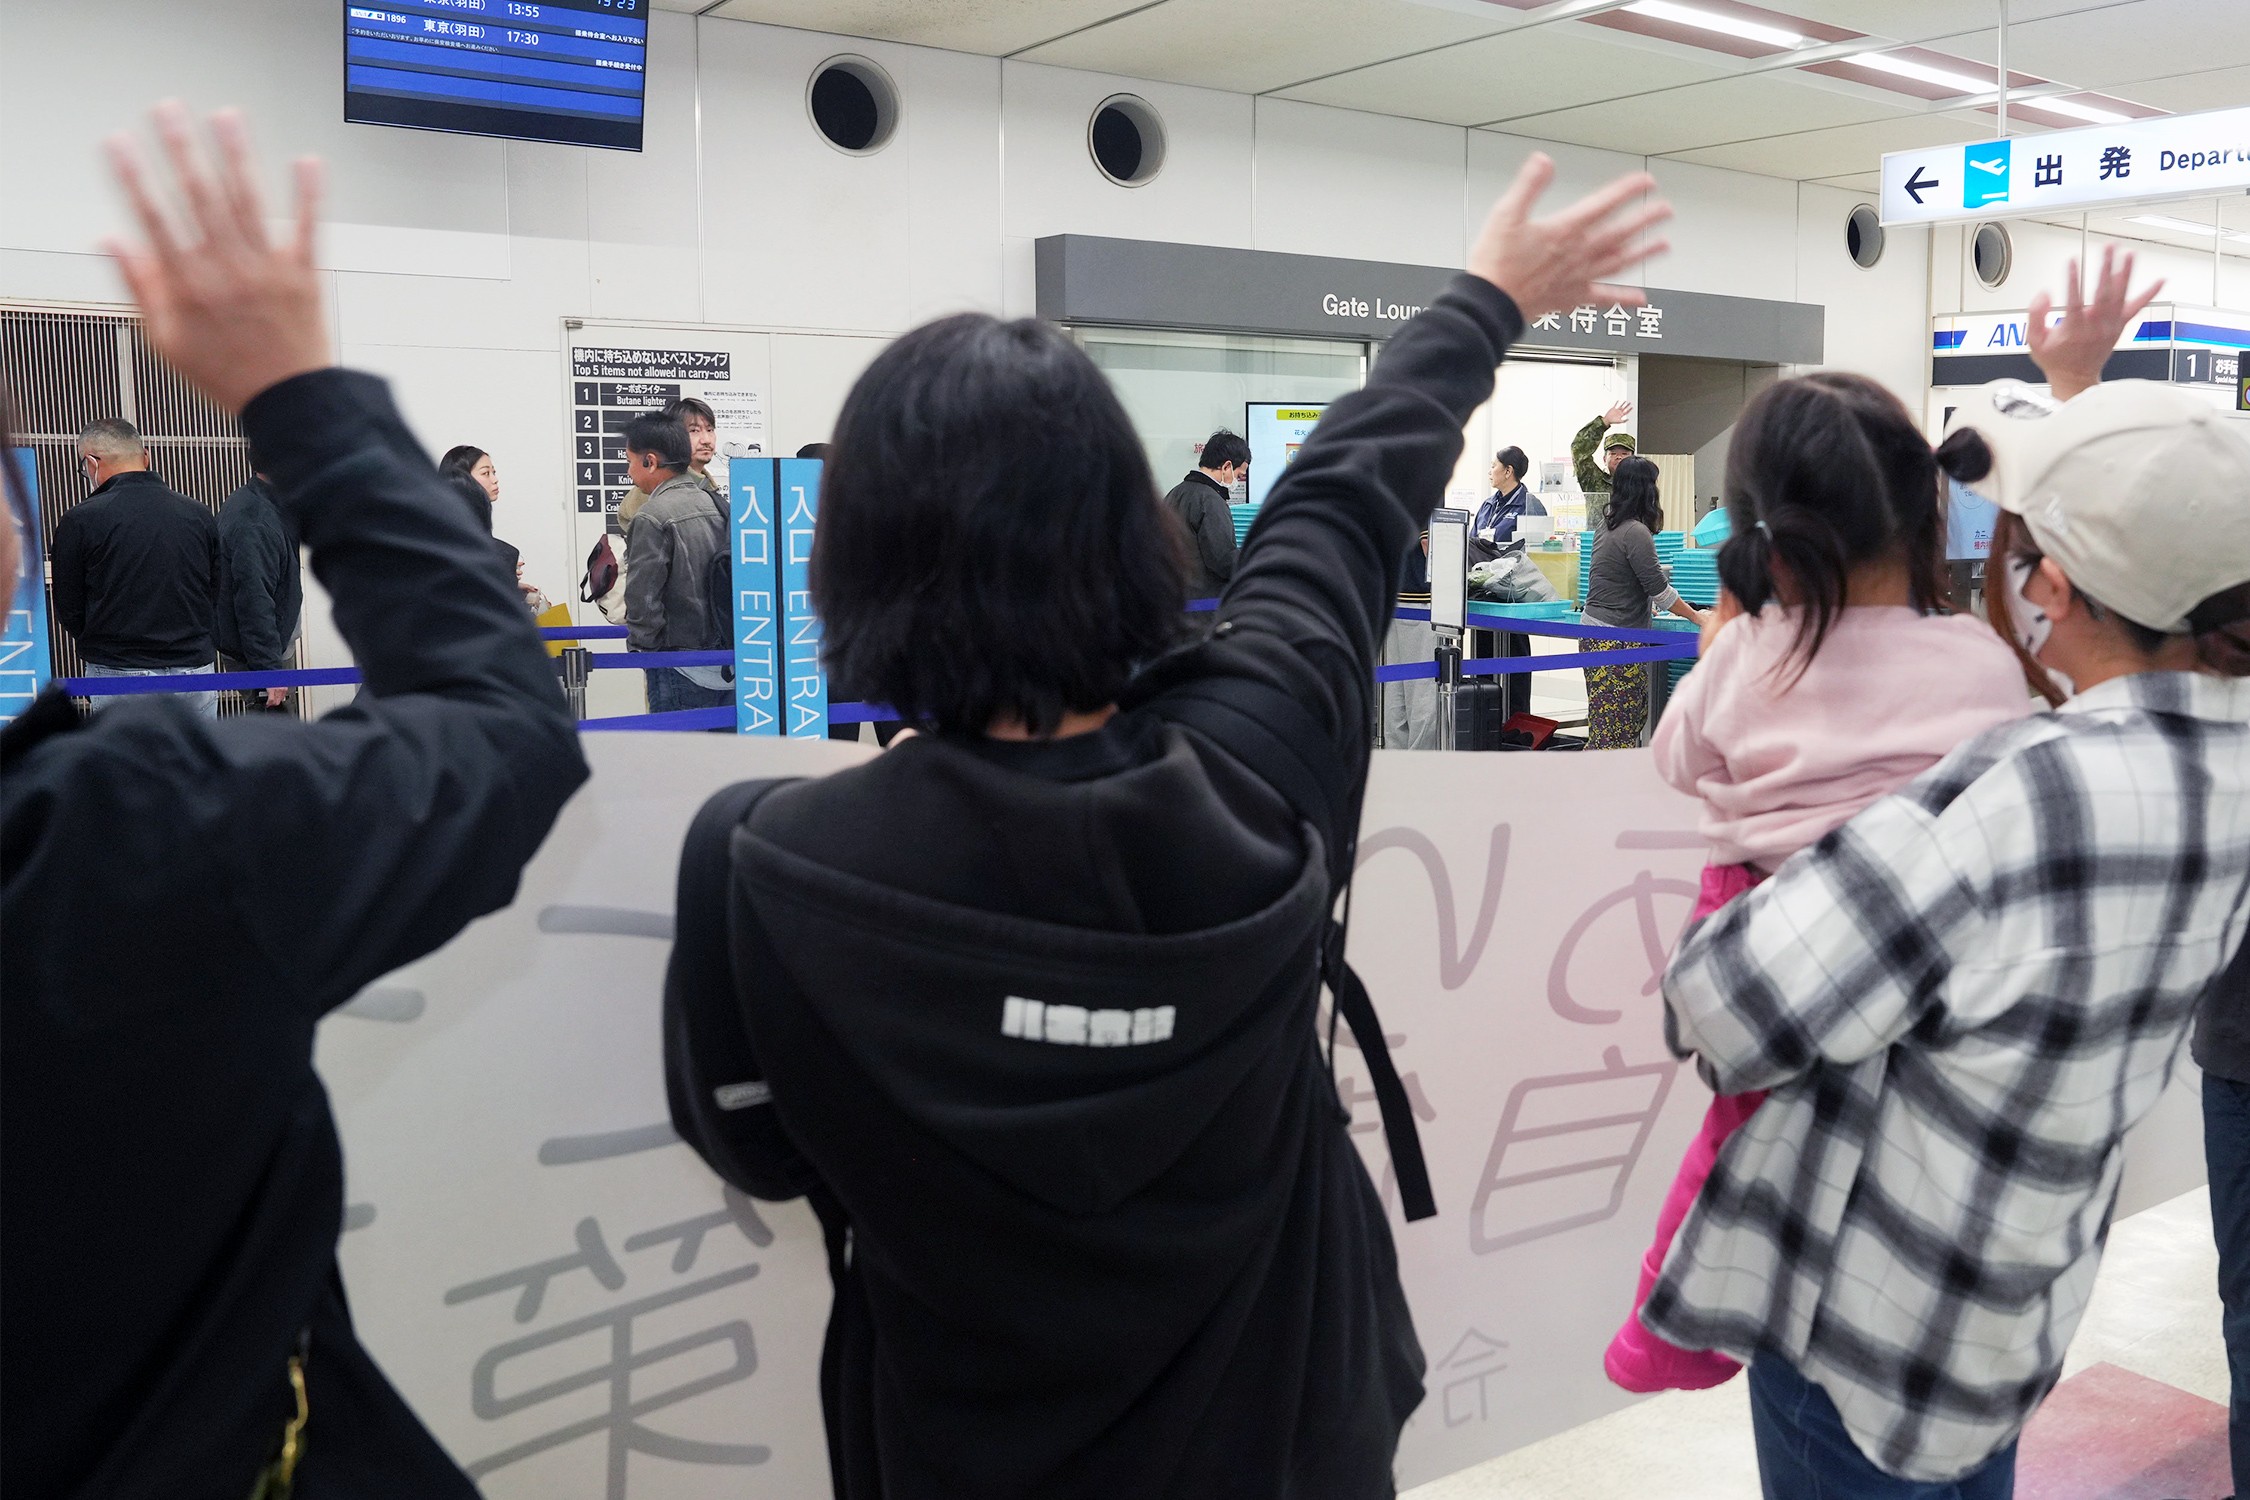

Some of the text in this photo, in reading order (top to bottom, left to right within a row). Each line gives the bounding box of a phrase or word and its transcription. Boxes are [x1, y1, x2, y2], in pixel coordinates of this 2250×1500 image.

[507, 3, 540, 18] 13:55
[386, 13, 407, 24] 1896
[423, 18, 486, 39] 東京(羽田)
[506, 30, 539, 46] 17:30
[1322, 293, 1370, 318] Gate
[1987, 323, 2034, 348] AN
[574, 365, 729, 380] Top 5 items not allowed in carry-ons
[2186, 353, 2197, 378] 1
[583, 388, 590, 401] 1
[616, 396, 667, 407] Butane lighter
[583, 416, 592, 429] 2
[584, 441, 592, 455] 3
[583, 468, 592, 481] 4
[585, 495, 594, 508] 5
[738, 486, 769, 565] 入口
